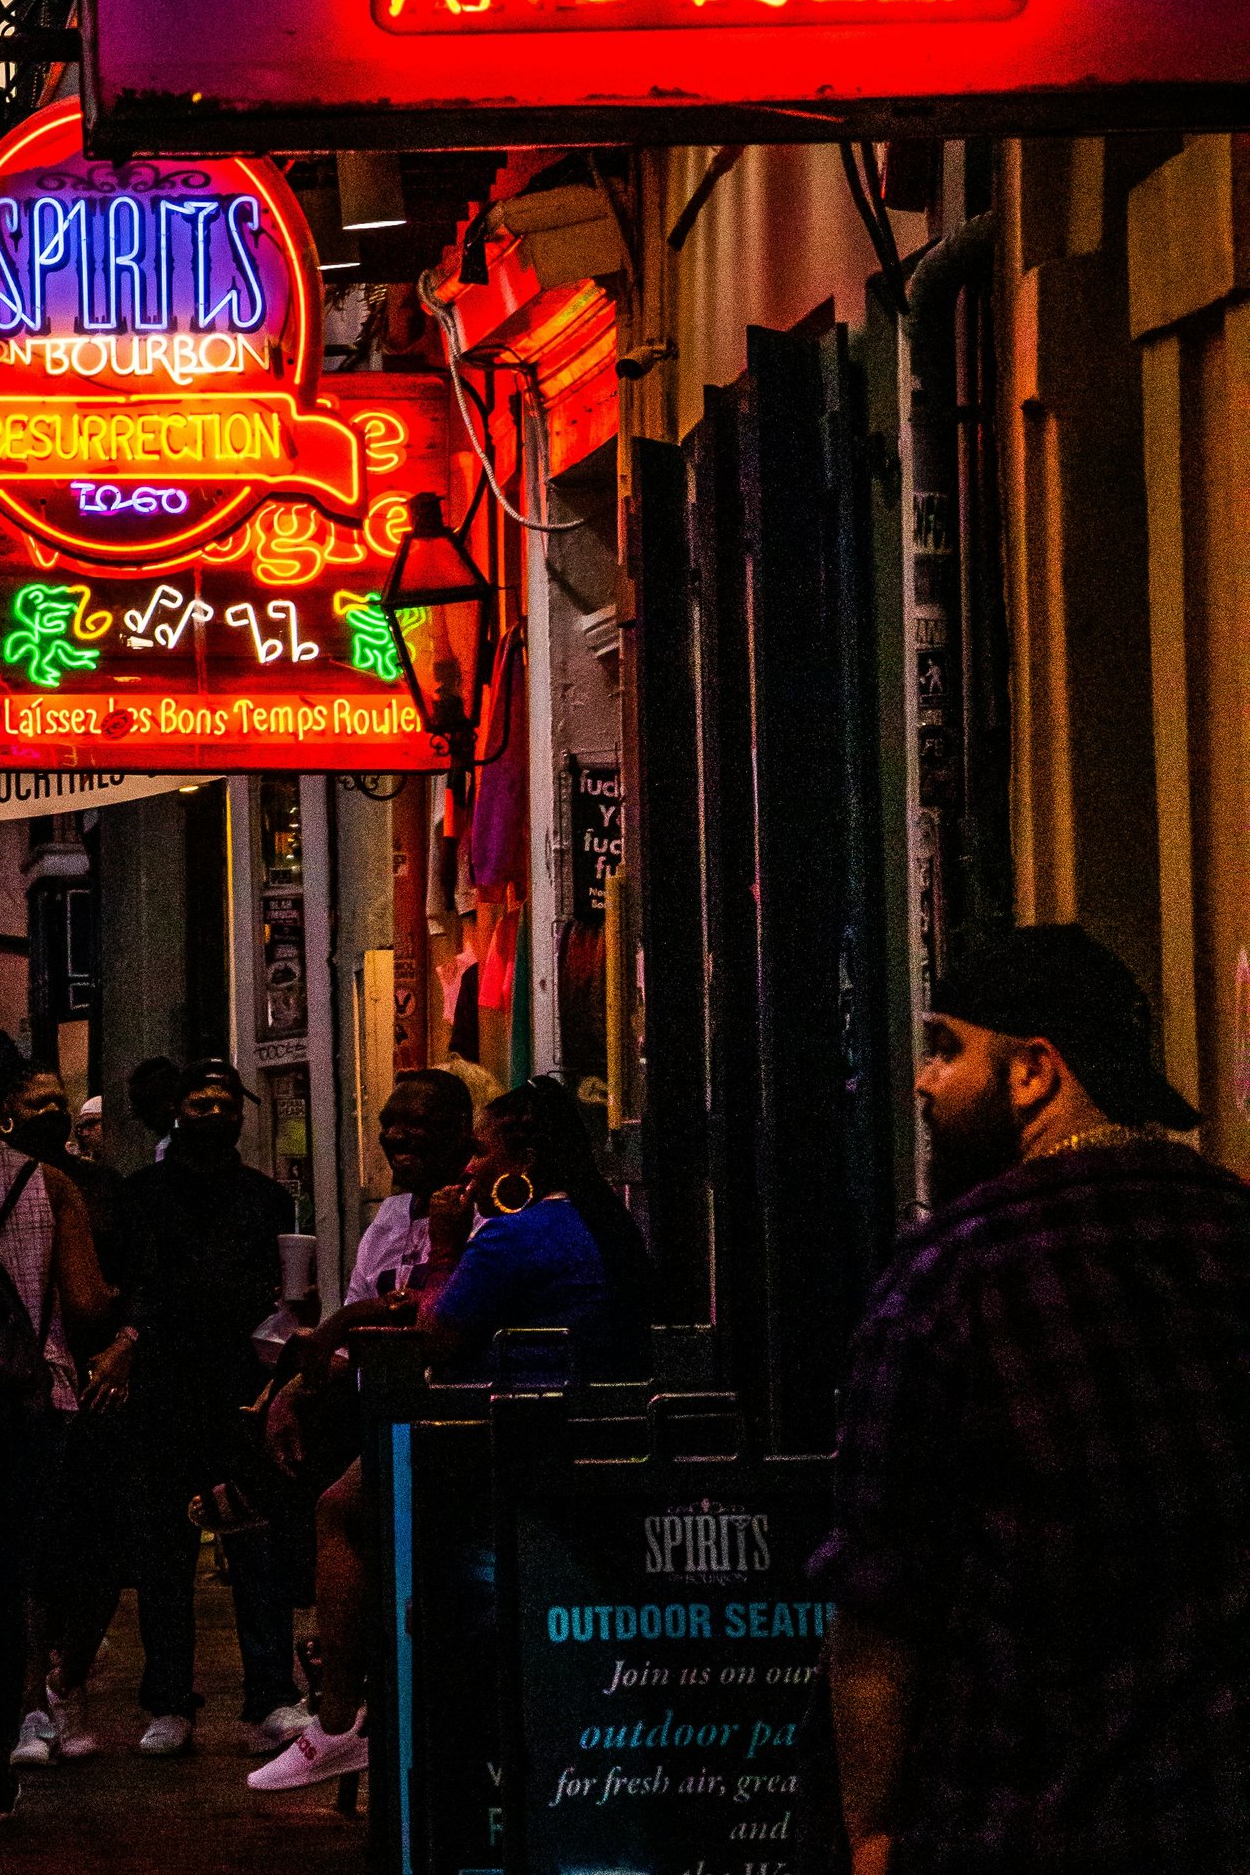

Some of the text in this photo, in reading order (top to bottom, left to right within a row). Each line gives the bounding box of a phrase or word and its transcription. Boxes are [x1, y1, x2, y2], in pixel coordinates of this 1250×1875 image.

[43, 332, 270, 386] BOURBON
[160, 697, 229, 736] Bons
[233, 698, 327, 741] Temps
[644, 1514, 770, 1573] SPIRITS
[546, 1602, 713, 1644] OUTDOOR
[603, 1659, 818, 1696] Join us on our
[579, 1708, 741, 1750] outdoor
[548, 1765, 597, 1808] for
[596, 1764, 670, 1807] fresh
[677, 1768, 727, 1798] air,
[729, 1811, 792, 1840] and
